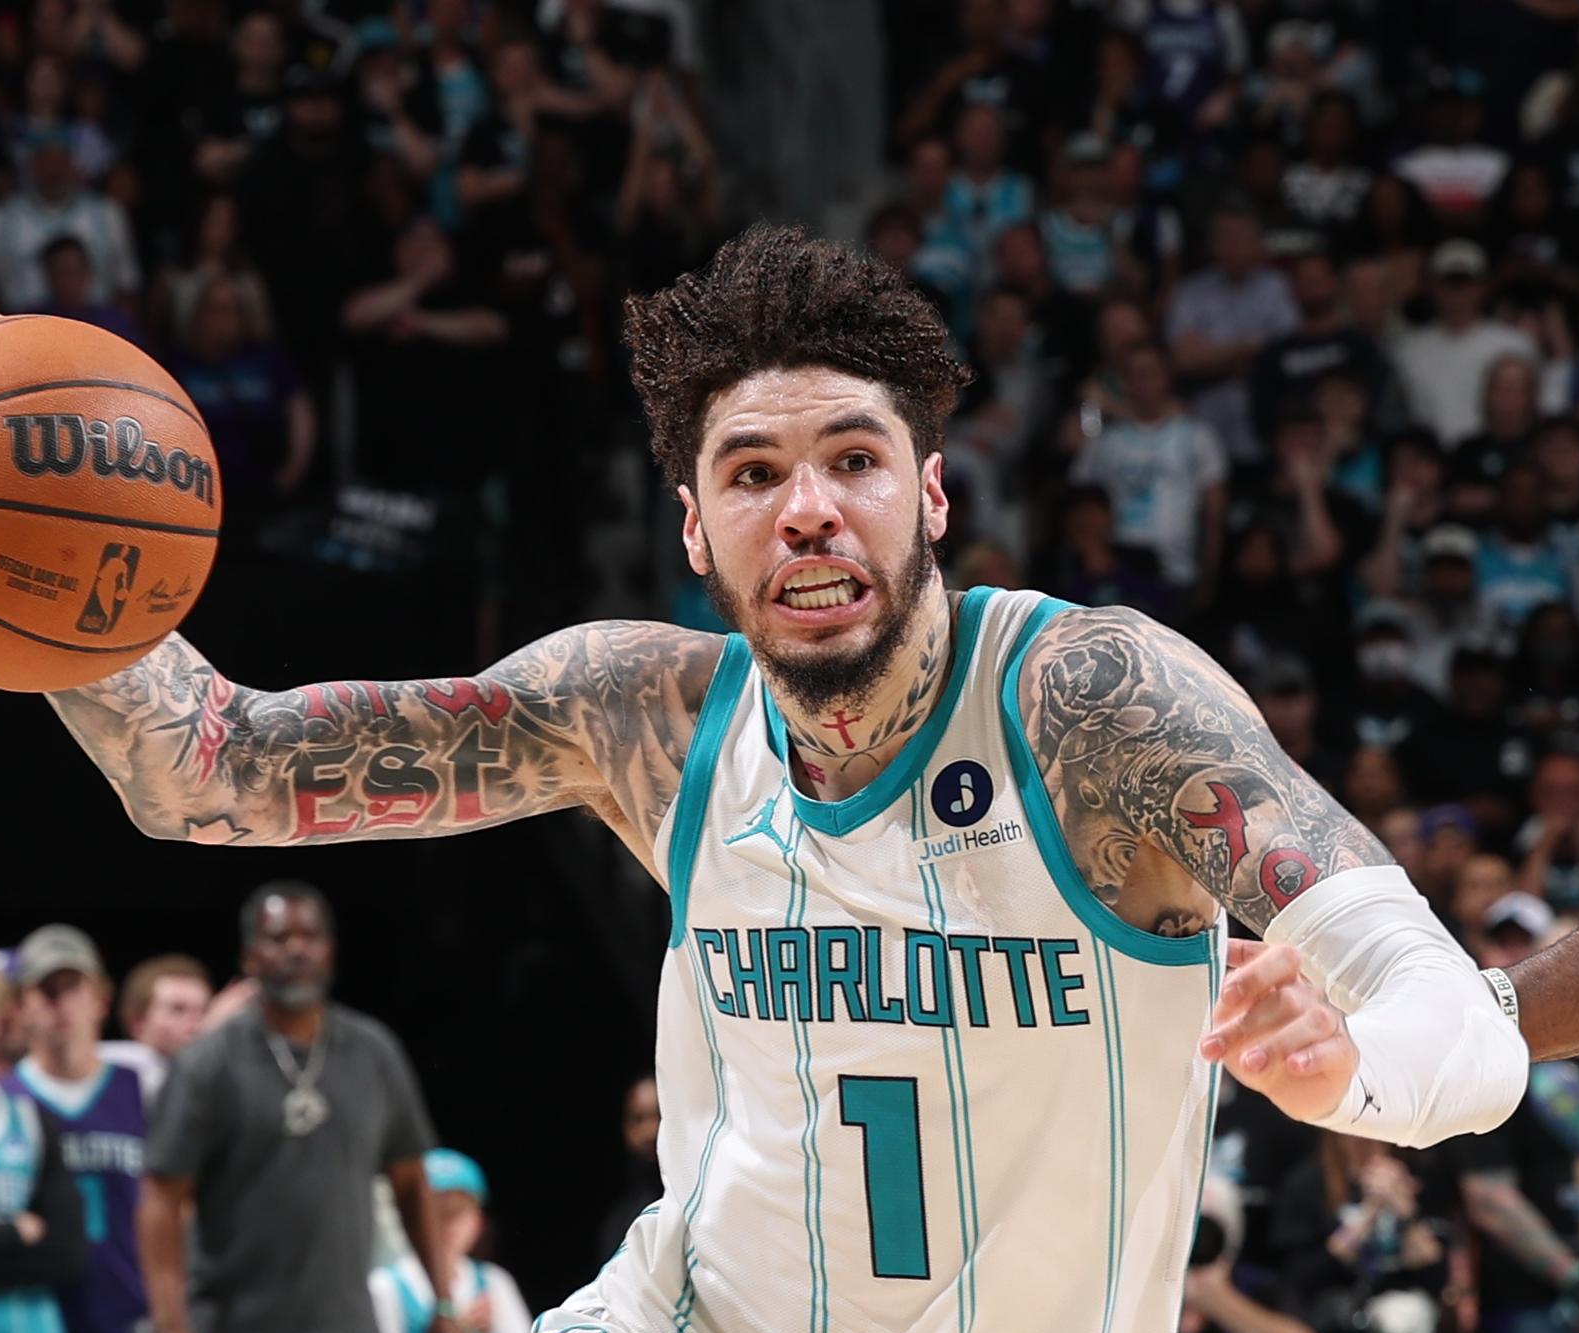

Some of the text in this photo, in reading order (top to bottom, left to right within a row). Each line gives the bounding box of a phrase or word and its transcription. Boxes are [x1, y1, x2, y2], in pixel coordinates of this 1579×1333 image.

[3, 413, 215, 509] Wilson
[920, 820, 1023, 860] Judi Health
[692, 926, 1091, 1029] CHARLOTTE
[838, 1073, 931, 1281] 1
